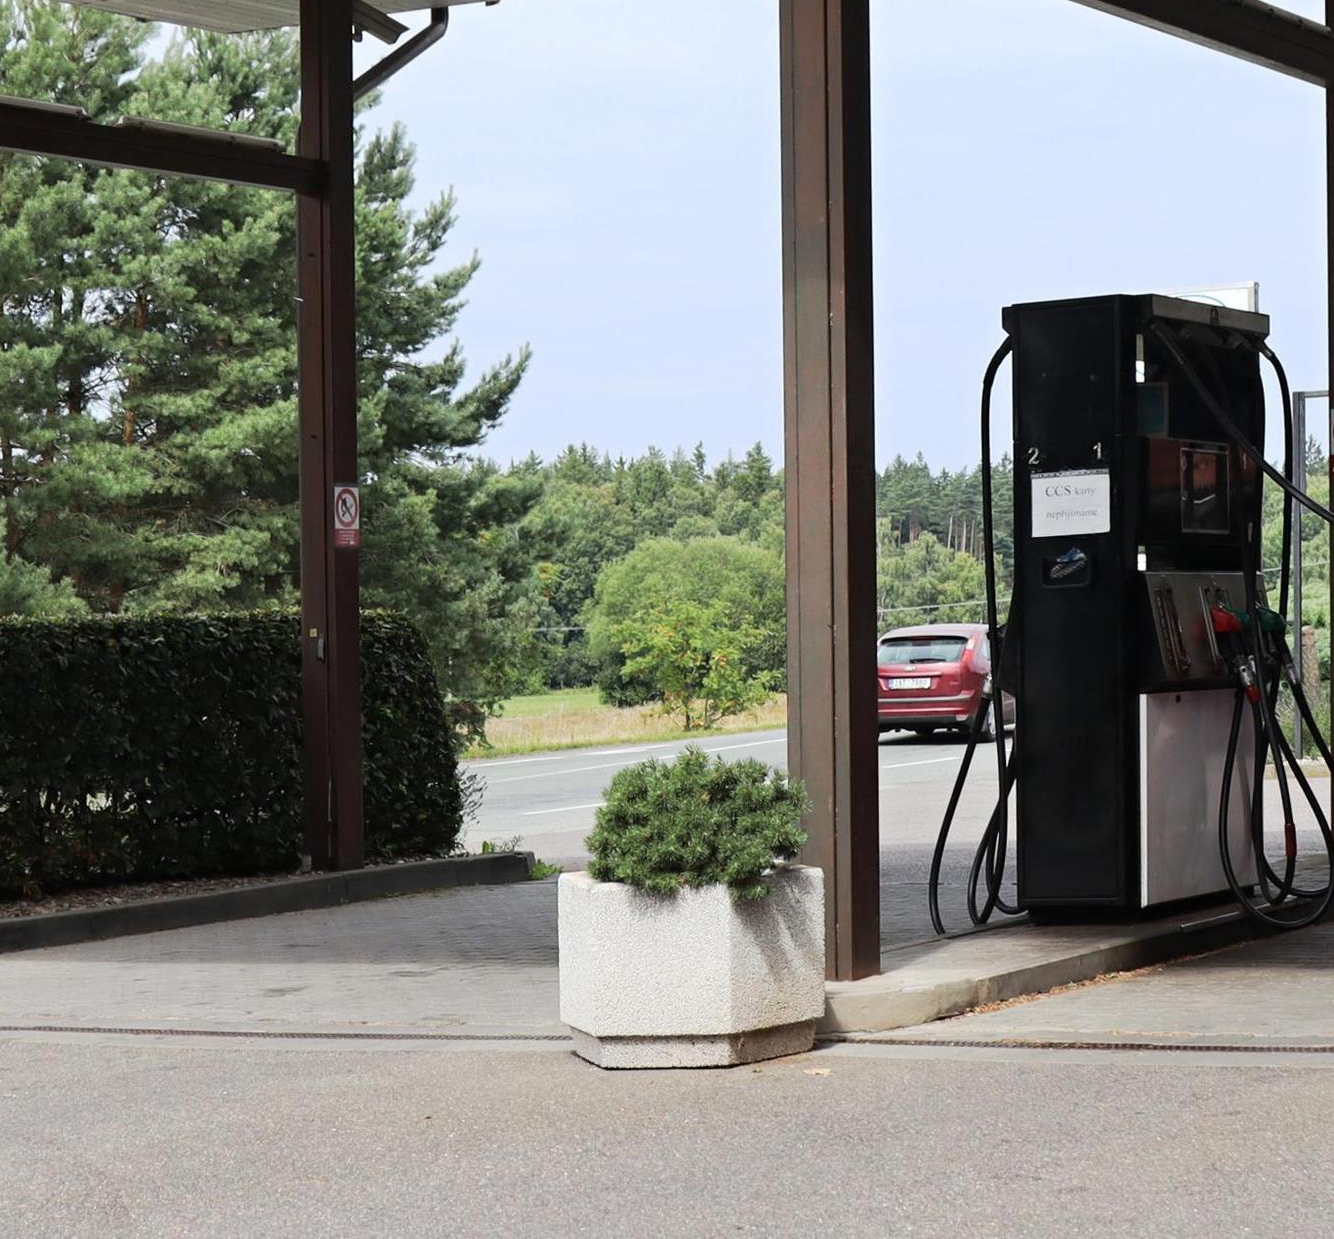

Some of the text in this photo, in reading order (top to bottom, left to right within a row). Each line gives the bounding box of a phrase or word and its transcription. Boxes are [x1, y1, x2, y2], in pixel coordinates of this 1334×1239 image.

[1028, 447, 1040, 465] 2
[1092, 442, 1102, 460] 1
[1045, 485, 1072, 497] CCS
